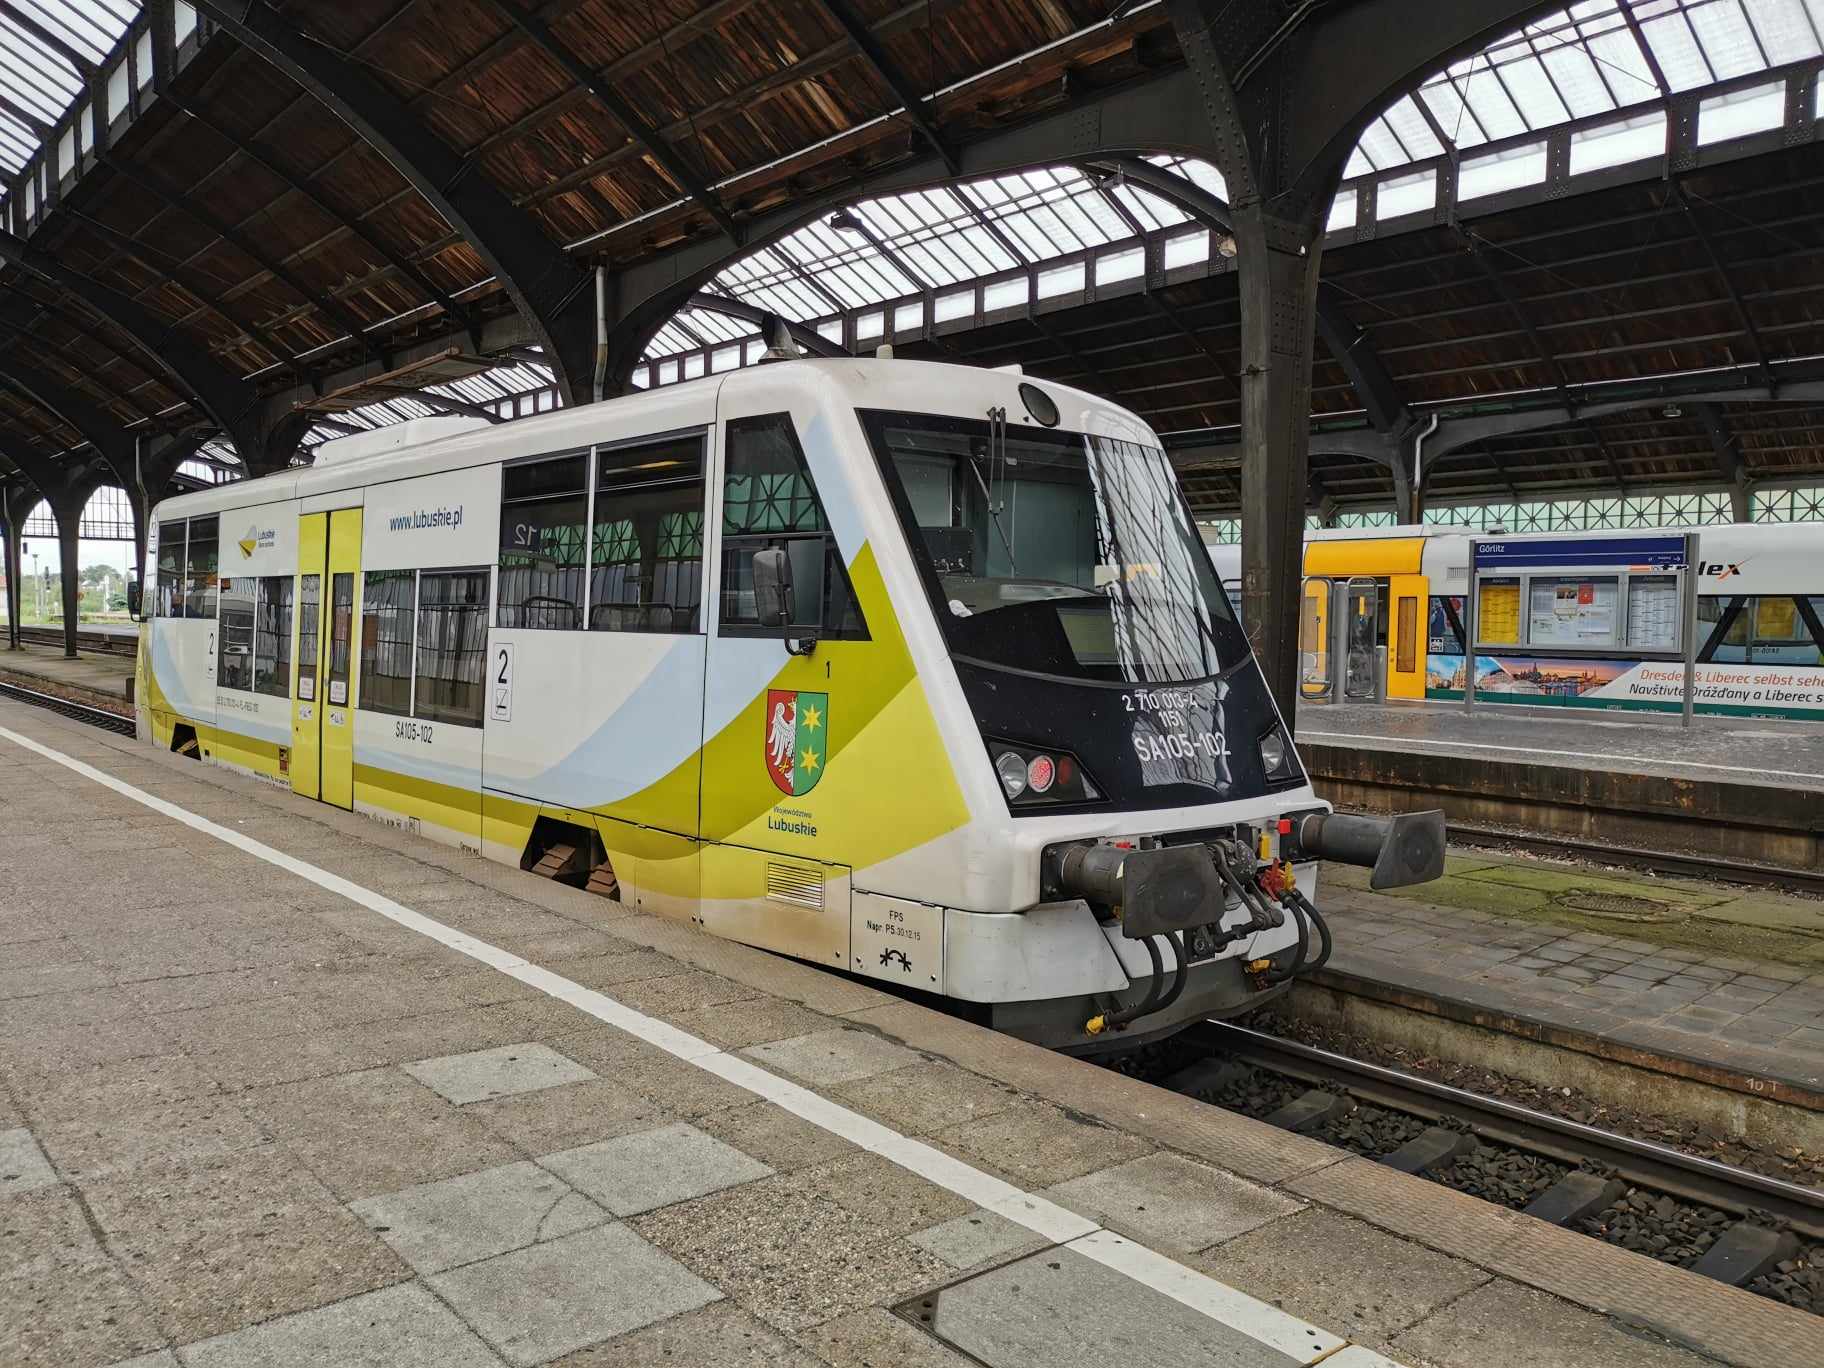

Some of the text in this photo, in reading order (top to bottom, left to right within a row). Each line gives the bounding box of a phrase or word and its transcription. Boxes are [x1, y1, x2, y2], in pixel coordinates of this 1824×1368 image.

[389, 504, 463, 532] www.lubuskie.pl
[1479, 543, 1505, 553] Görlitz
[209, 632, 215, 655] 2
[497, 649, 509, 684] 2
[825, 661, 831, 679] 1
[1640, 668, 1693, 683] Dresde
[1695, 671, 1703, 682] &
[1705, 671, 1750, 685] Liberec
[1752, 673, 1793, 686] selbst
[1121, 692, 1199, 712] 2 710 013-4
[1752, 691, 1762, 700] a
[1765, 689, 1813, 703] Liberec
[1157, 710, 1185, 728] 1151
[395, 720, 433, 744] SA105-102
[1133, 731, 1232, 762] SA105-102
[767, 815, 817, 837] Lubuskie
[889, 910, 904, 922] FPS
